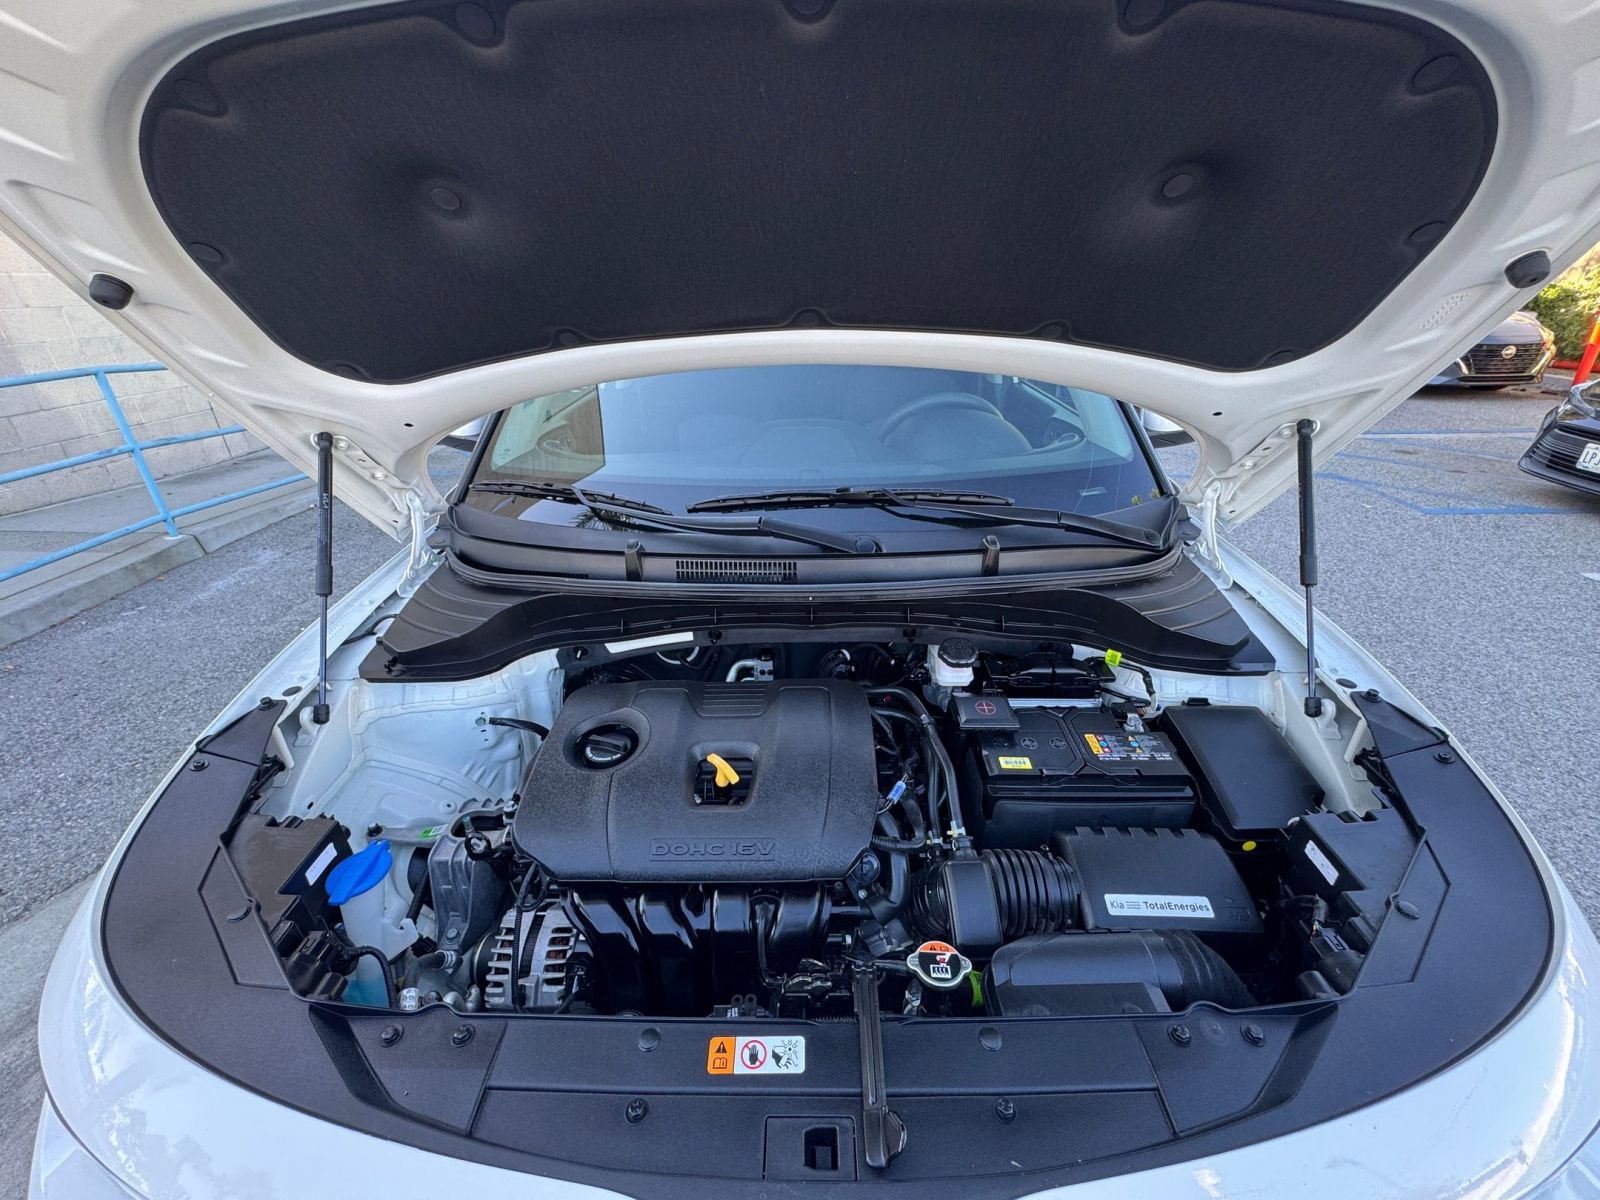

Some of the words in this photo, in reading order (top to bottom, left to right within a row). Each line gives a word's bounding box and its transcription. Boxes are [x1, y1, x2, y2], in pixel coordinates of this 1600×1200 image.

[651, 841, 725, 856] DOHC
[731, 841, 776, 856] 16V
[1110, 900, 1126, 910] Kia
[1143, 901, 1210, 913] TotalEnergies
